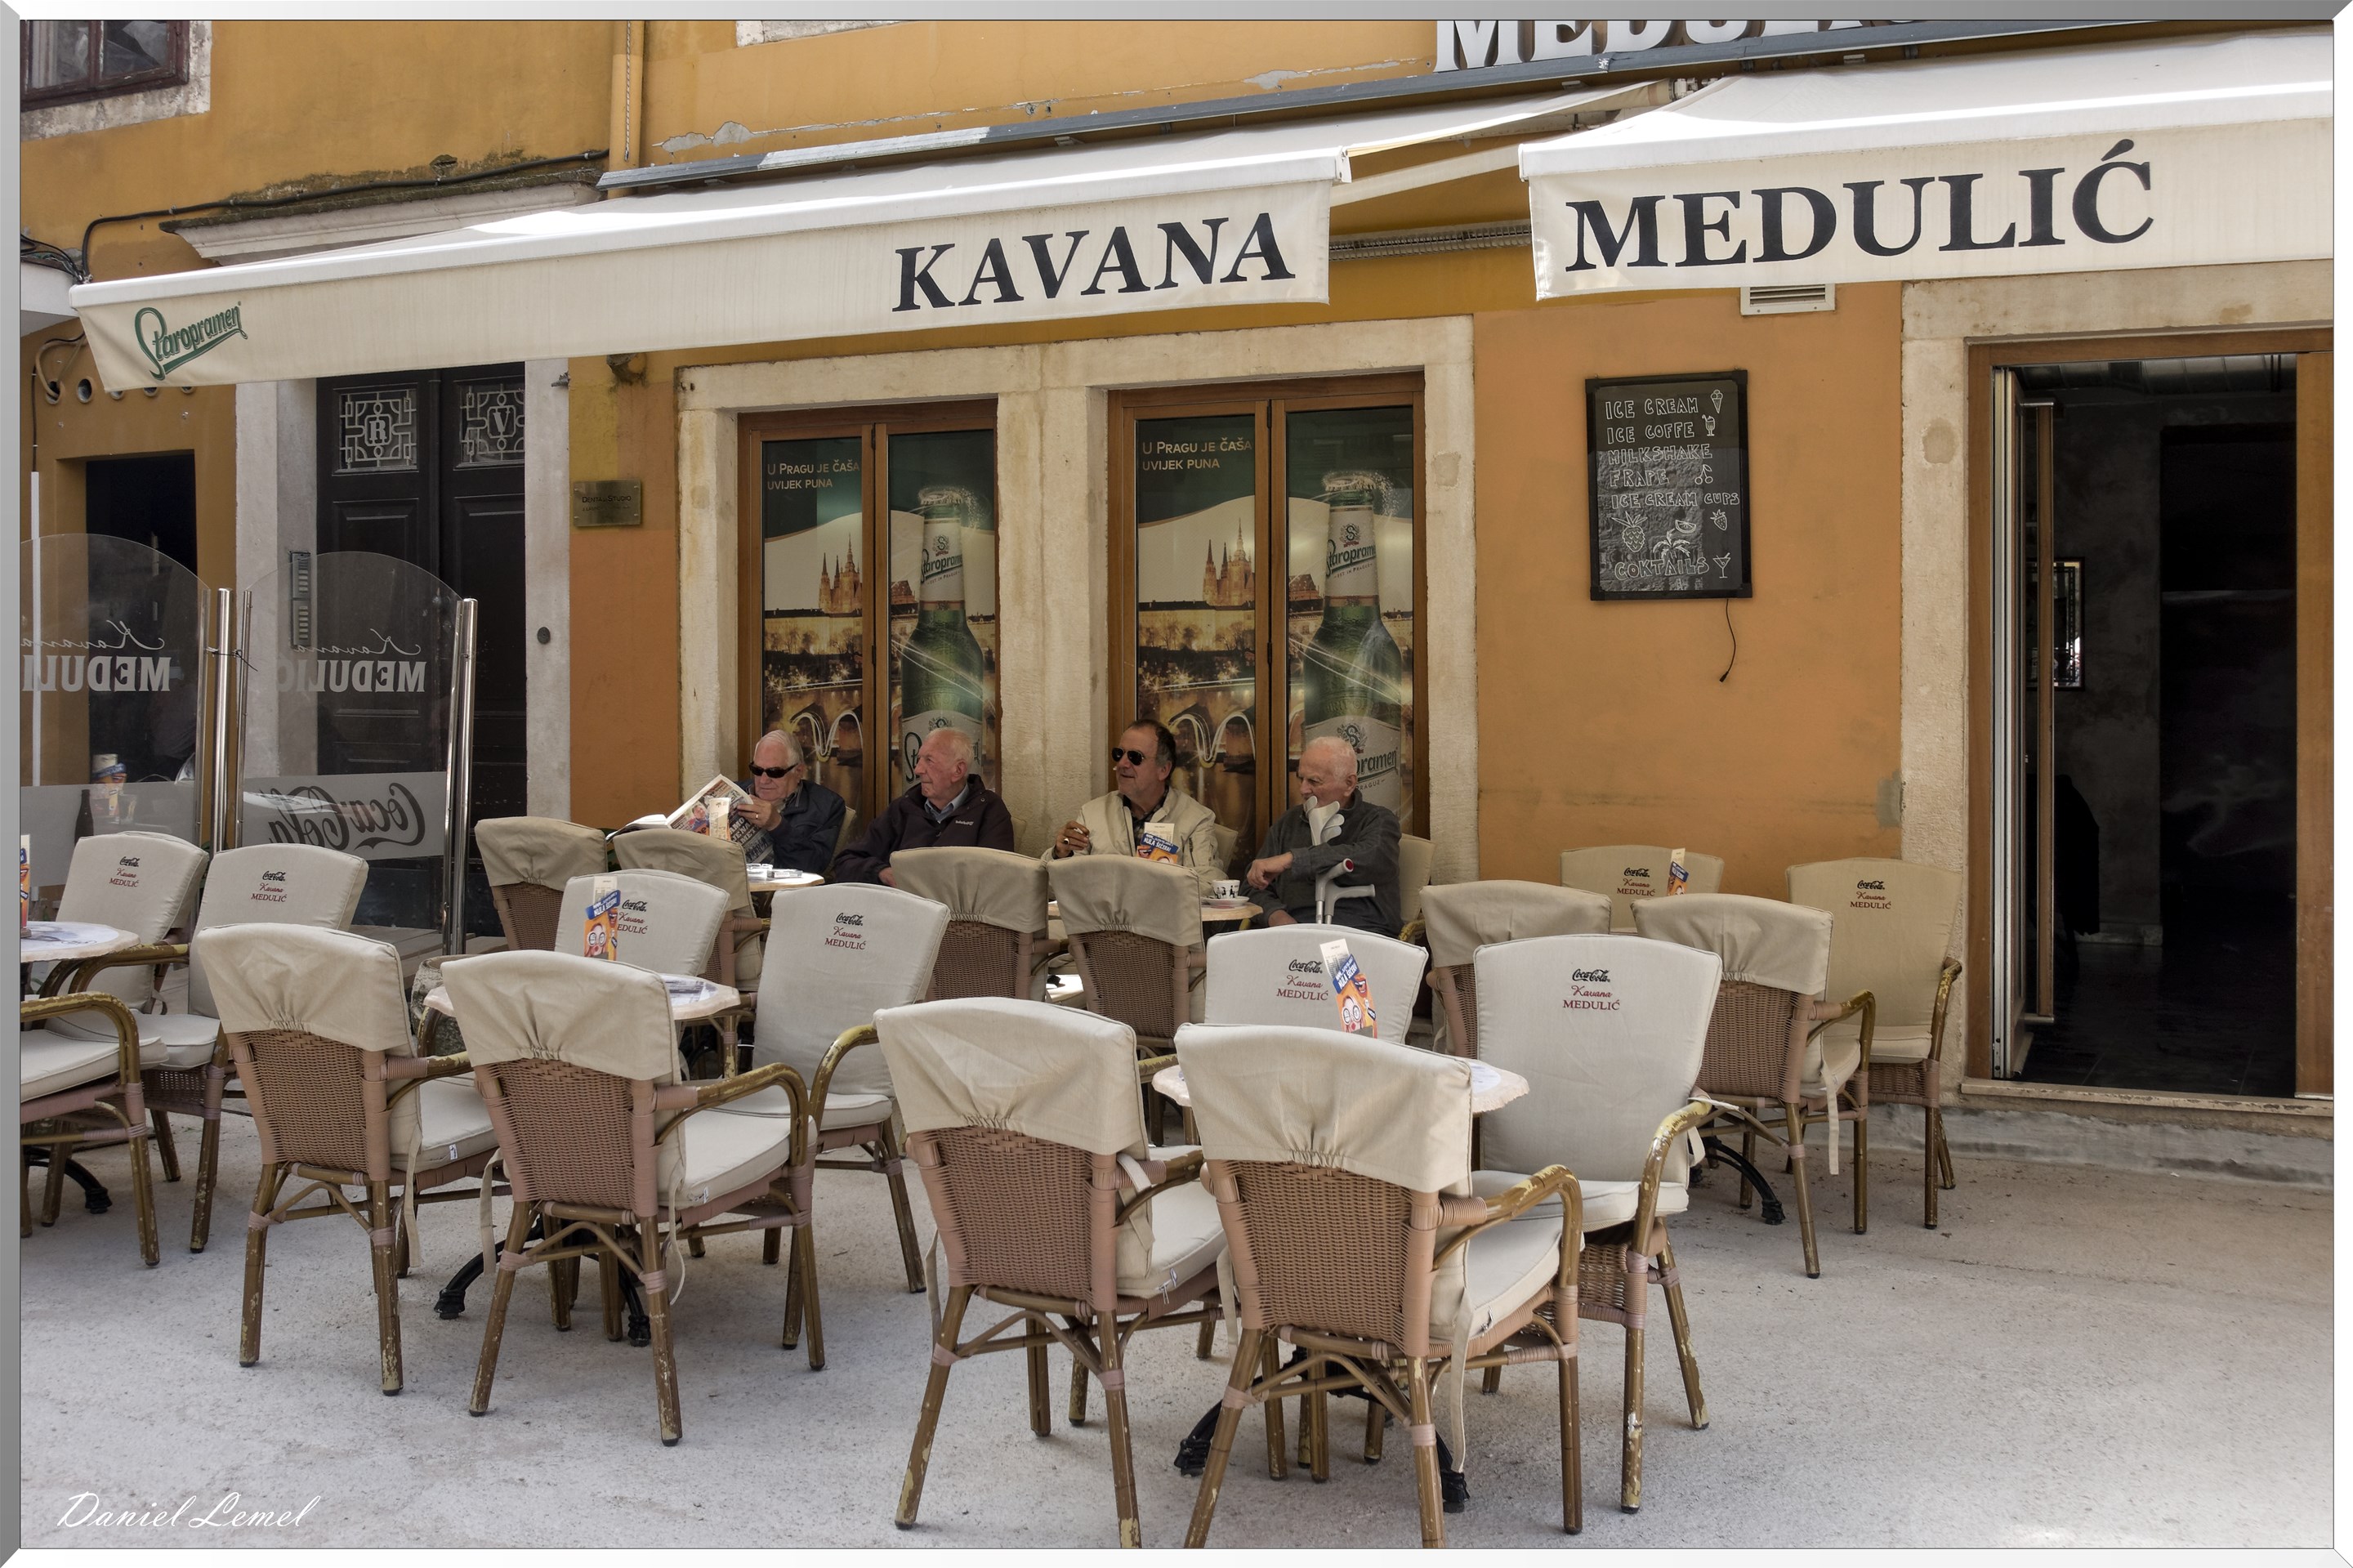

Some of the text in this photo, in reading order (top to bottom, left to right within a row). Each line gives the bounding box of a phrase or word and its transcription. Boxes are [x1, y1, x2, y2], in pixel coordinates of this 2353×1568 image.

[1565, 139, 2154, 273] MEDULIĆ
[892, 212, 1296, 313] KAVANA
[134, 301, 248, 381] Staropramen
[1605, 397, 1699, 420] ICE CREAM
[493, 409, 511, 432] V
[369, 420, 387, 443] R
[1606, 422, 1695, 444] ICE COFFE
[1142, 442, 1153, 454] U
[1201, 441, 1216, 453] JE
[1220, 437, 1252, 452] ČAŠA
[1607, 443, 1712, 465] MILKSHAKE
[766, 463, 776, 476] U
[817, 463, 829, 473] JE
[832, 459, 860, 473] ČAŠA
[1142, 458, 1221, 471] UVIJEK PUNA
[766, 478, 833, 490] UVIJEK PUNA
[1609, 468, 1670, 487] FRAPE
[1611, 492, 1740, 509] ICE CREAM CUPS
[1614, 556, 1710, 581] COKTAILS
[250, 892, 288, 903] MEDULIĆ
[1616, 887, 1656, 897] MEDULIĆ
[1850, 900, 1892, 909] MEDULIĆ
[835, 912, 864, 926] Coca-Cola
[617, 923, 649, 935] EDULIĆ
[824, 937, 867, 950] MEDULIĆ
[1288, 958, 1323, 973] Coca-Cola
[1572, 968, 1610, 982] Coca-Cola
[1276, 988, 1329, 1001] MEDULIĆ
[1562, 998, 1621, 1011] MEDULIĆ
